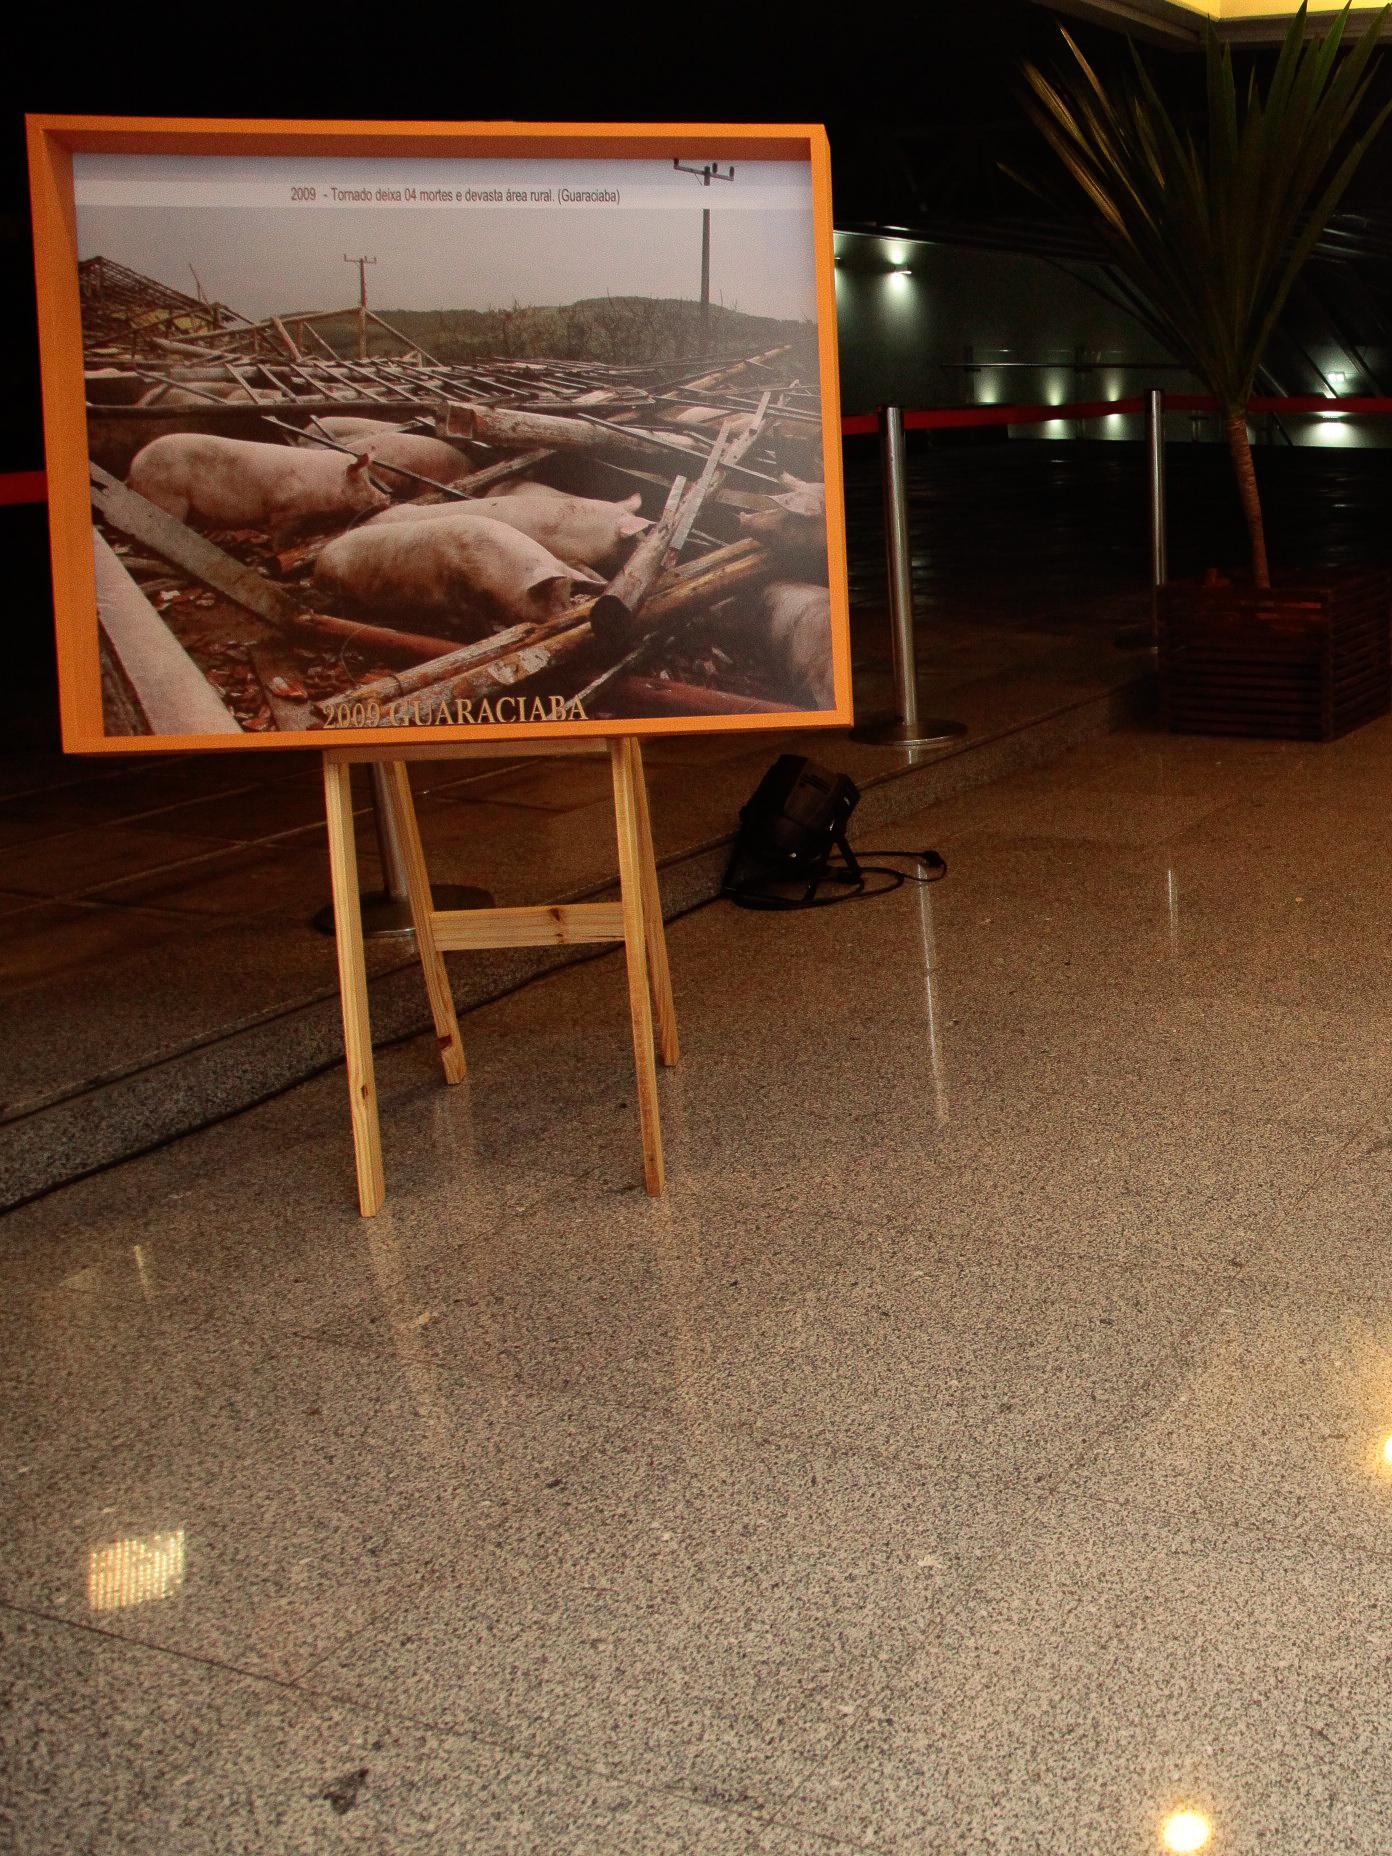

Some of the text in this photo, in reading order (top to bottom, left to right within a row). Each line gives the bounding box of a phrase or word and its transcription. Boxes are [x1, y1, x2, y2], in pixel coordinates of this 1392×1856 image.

[291, 187, 316, 201] 2009
[330, 187, 373, 202] Tornado
[375, 188, 402, 202] deixa
[404, 188, 417, 202] 04
[419, 189, 453, 202] mortes
[456, 191, 462, 202] e
[465, 188, 503, 202] devasta
[506, 188, 528, 202] área
[530, 189, 555, 202] rural.
[557, 188, 620, 205] (Guaraciaba)
[322, 694, 589, 729] 2009 GUARACIABA
